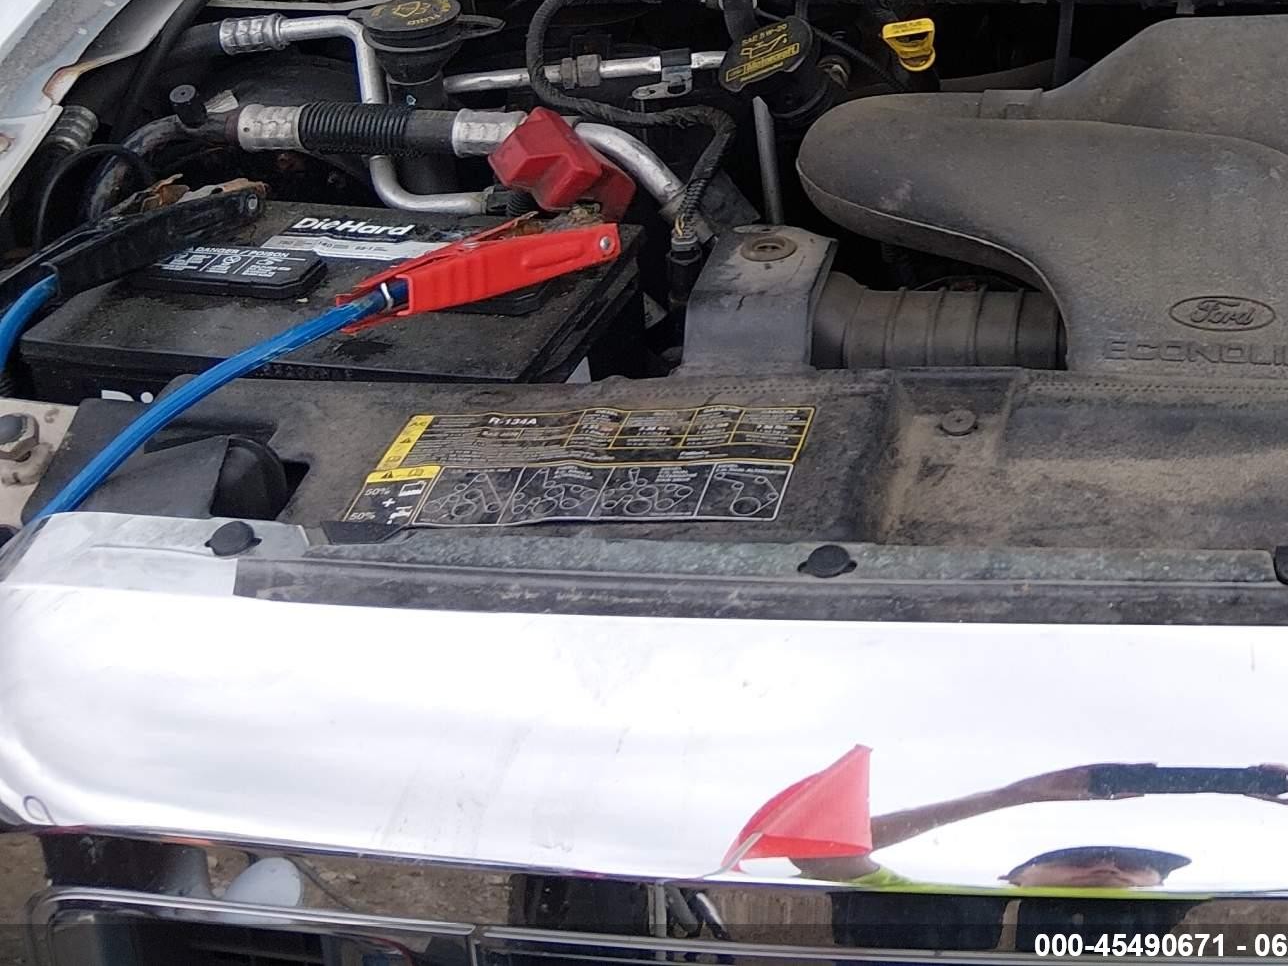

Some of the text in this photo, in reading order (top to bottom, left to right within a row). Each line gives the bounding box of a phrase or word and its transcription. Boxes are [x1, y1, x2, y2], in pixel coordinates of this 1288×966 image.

[292, 217, 415, 236] DieHard
[194, 247, 239, 255] DANGER
[251, 250, 289, 258] POISON
[1190, 299, 1255, 325] Ford
[487, 417, 537, 426] R-134A
[365, 487, 391, 497] 50%
[349, 512, 376, 521] 50%
